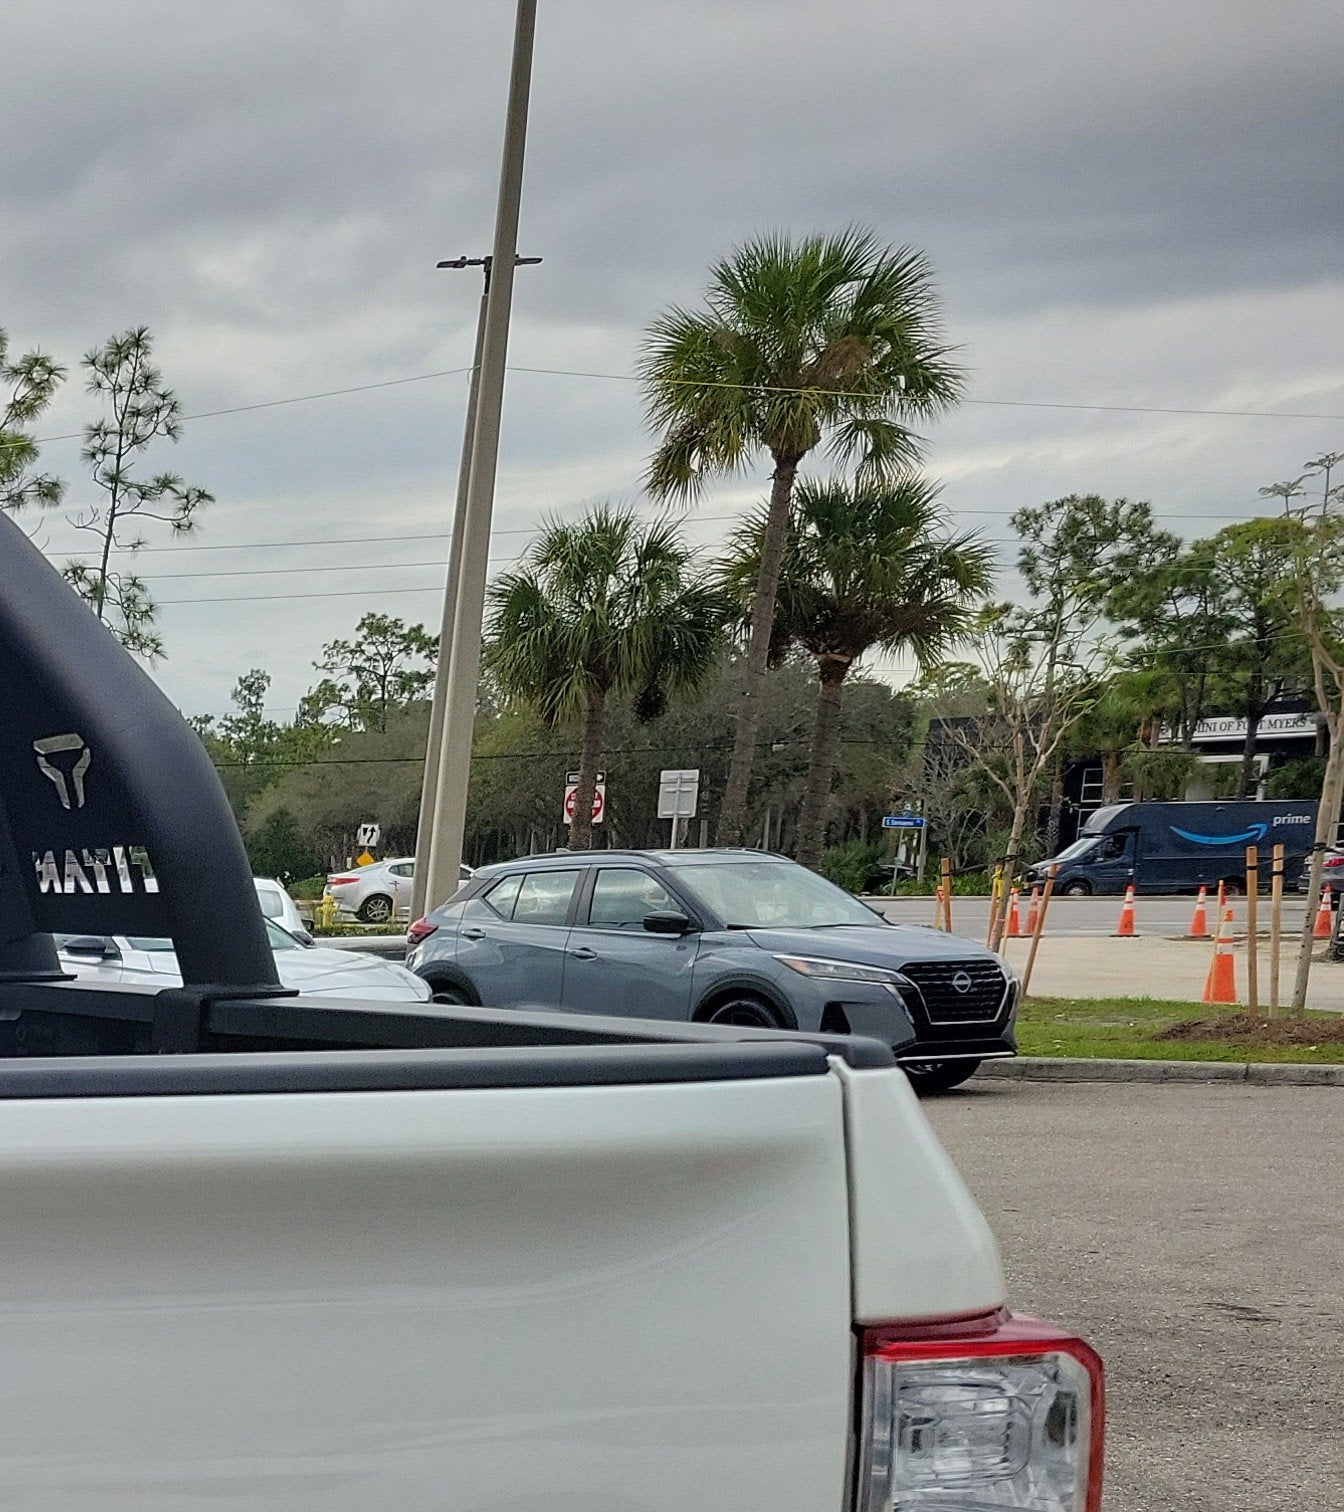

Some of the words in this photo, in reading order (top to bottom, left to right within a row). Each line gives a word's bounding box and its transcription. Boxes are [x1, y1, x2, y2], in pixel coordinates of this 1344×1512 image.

[1219, 720, 1234, 732] OF
[1235, 719, 1266, 731] FOT
[1267, 717, 1306, 730] MYERS
[1272, 813, 1311, 827] prime
